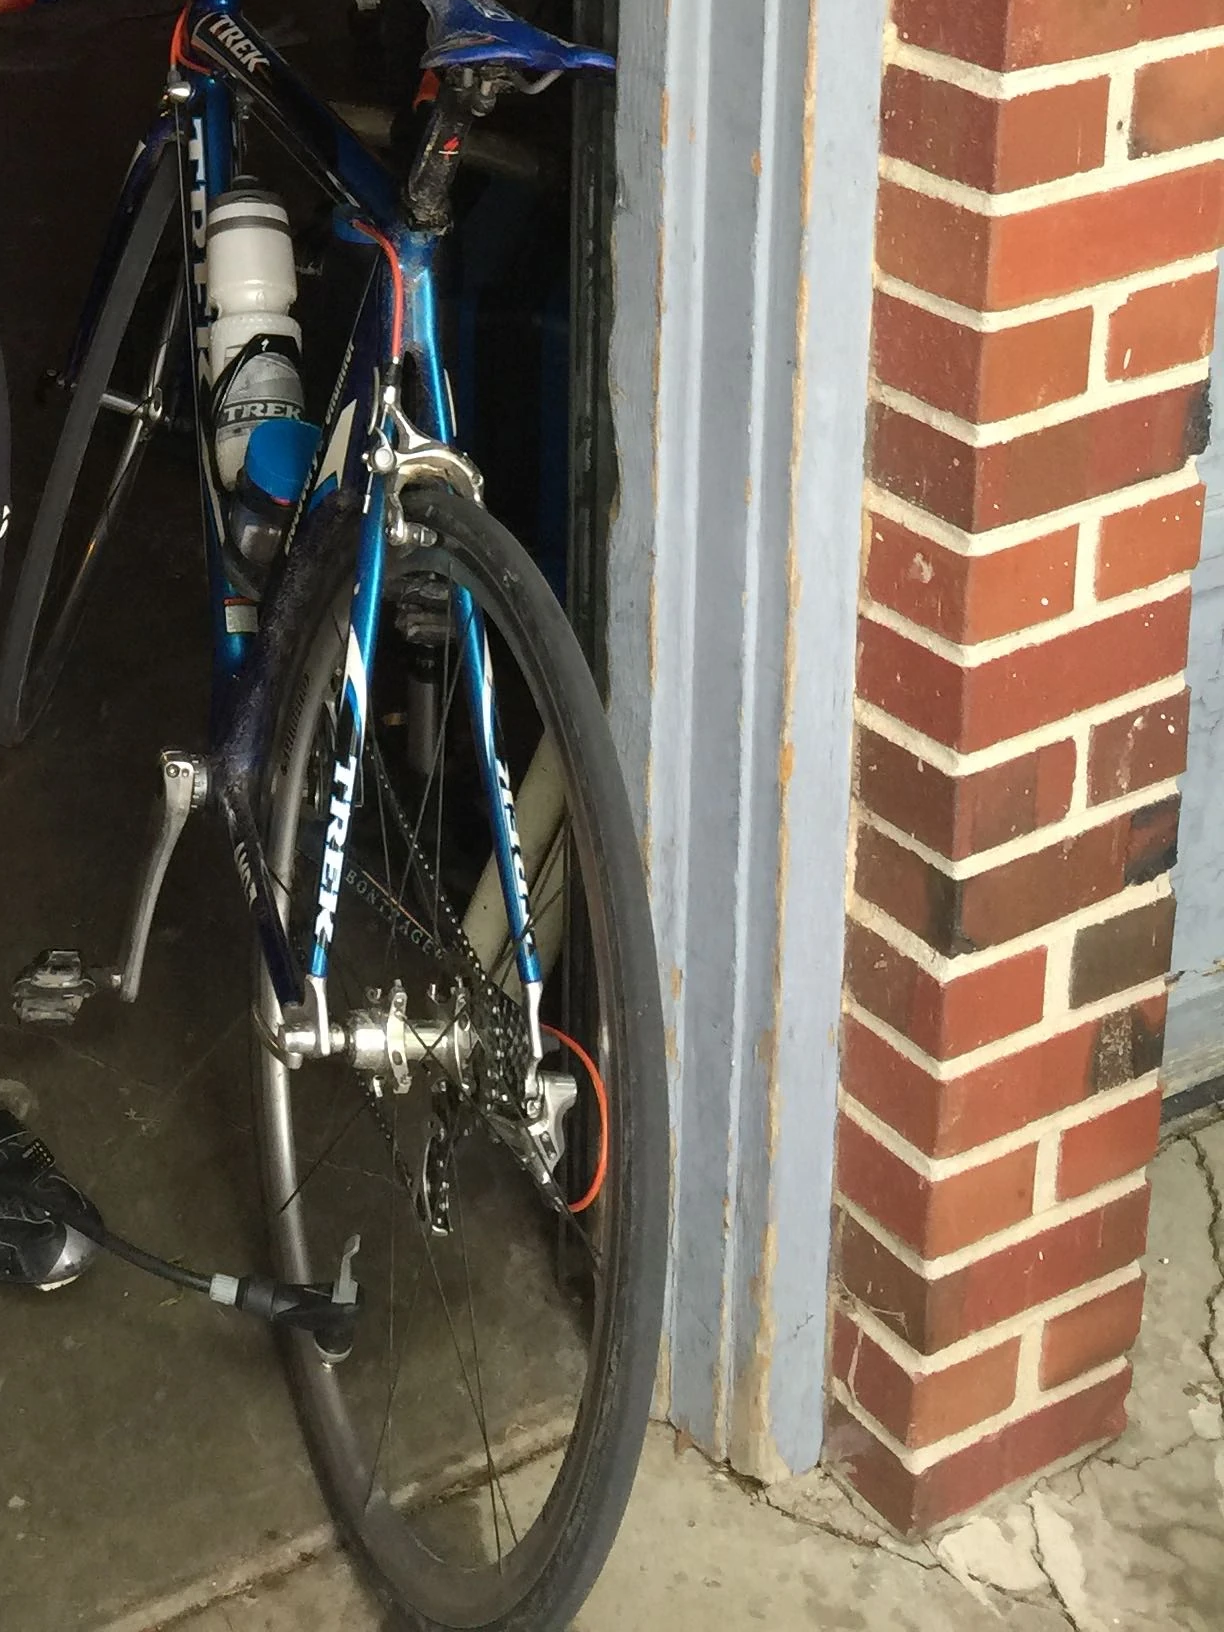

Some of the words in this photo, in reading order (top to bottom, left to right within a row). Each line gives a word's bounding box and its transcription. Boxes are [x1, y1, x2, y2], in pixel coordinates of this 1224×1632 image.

[208, 13, 271, 74] TREK
[223, 401, 302, 422] TREK
[313, 755, 358, 945] TREK
